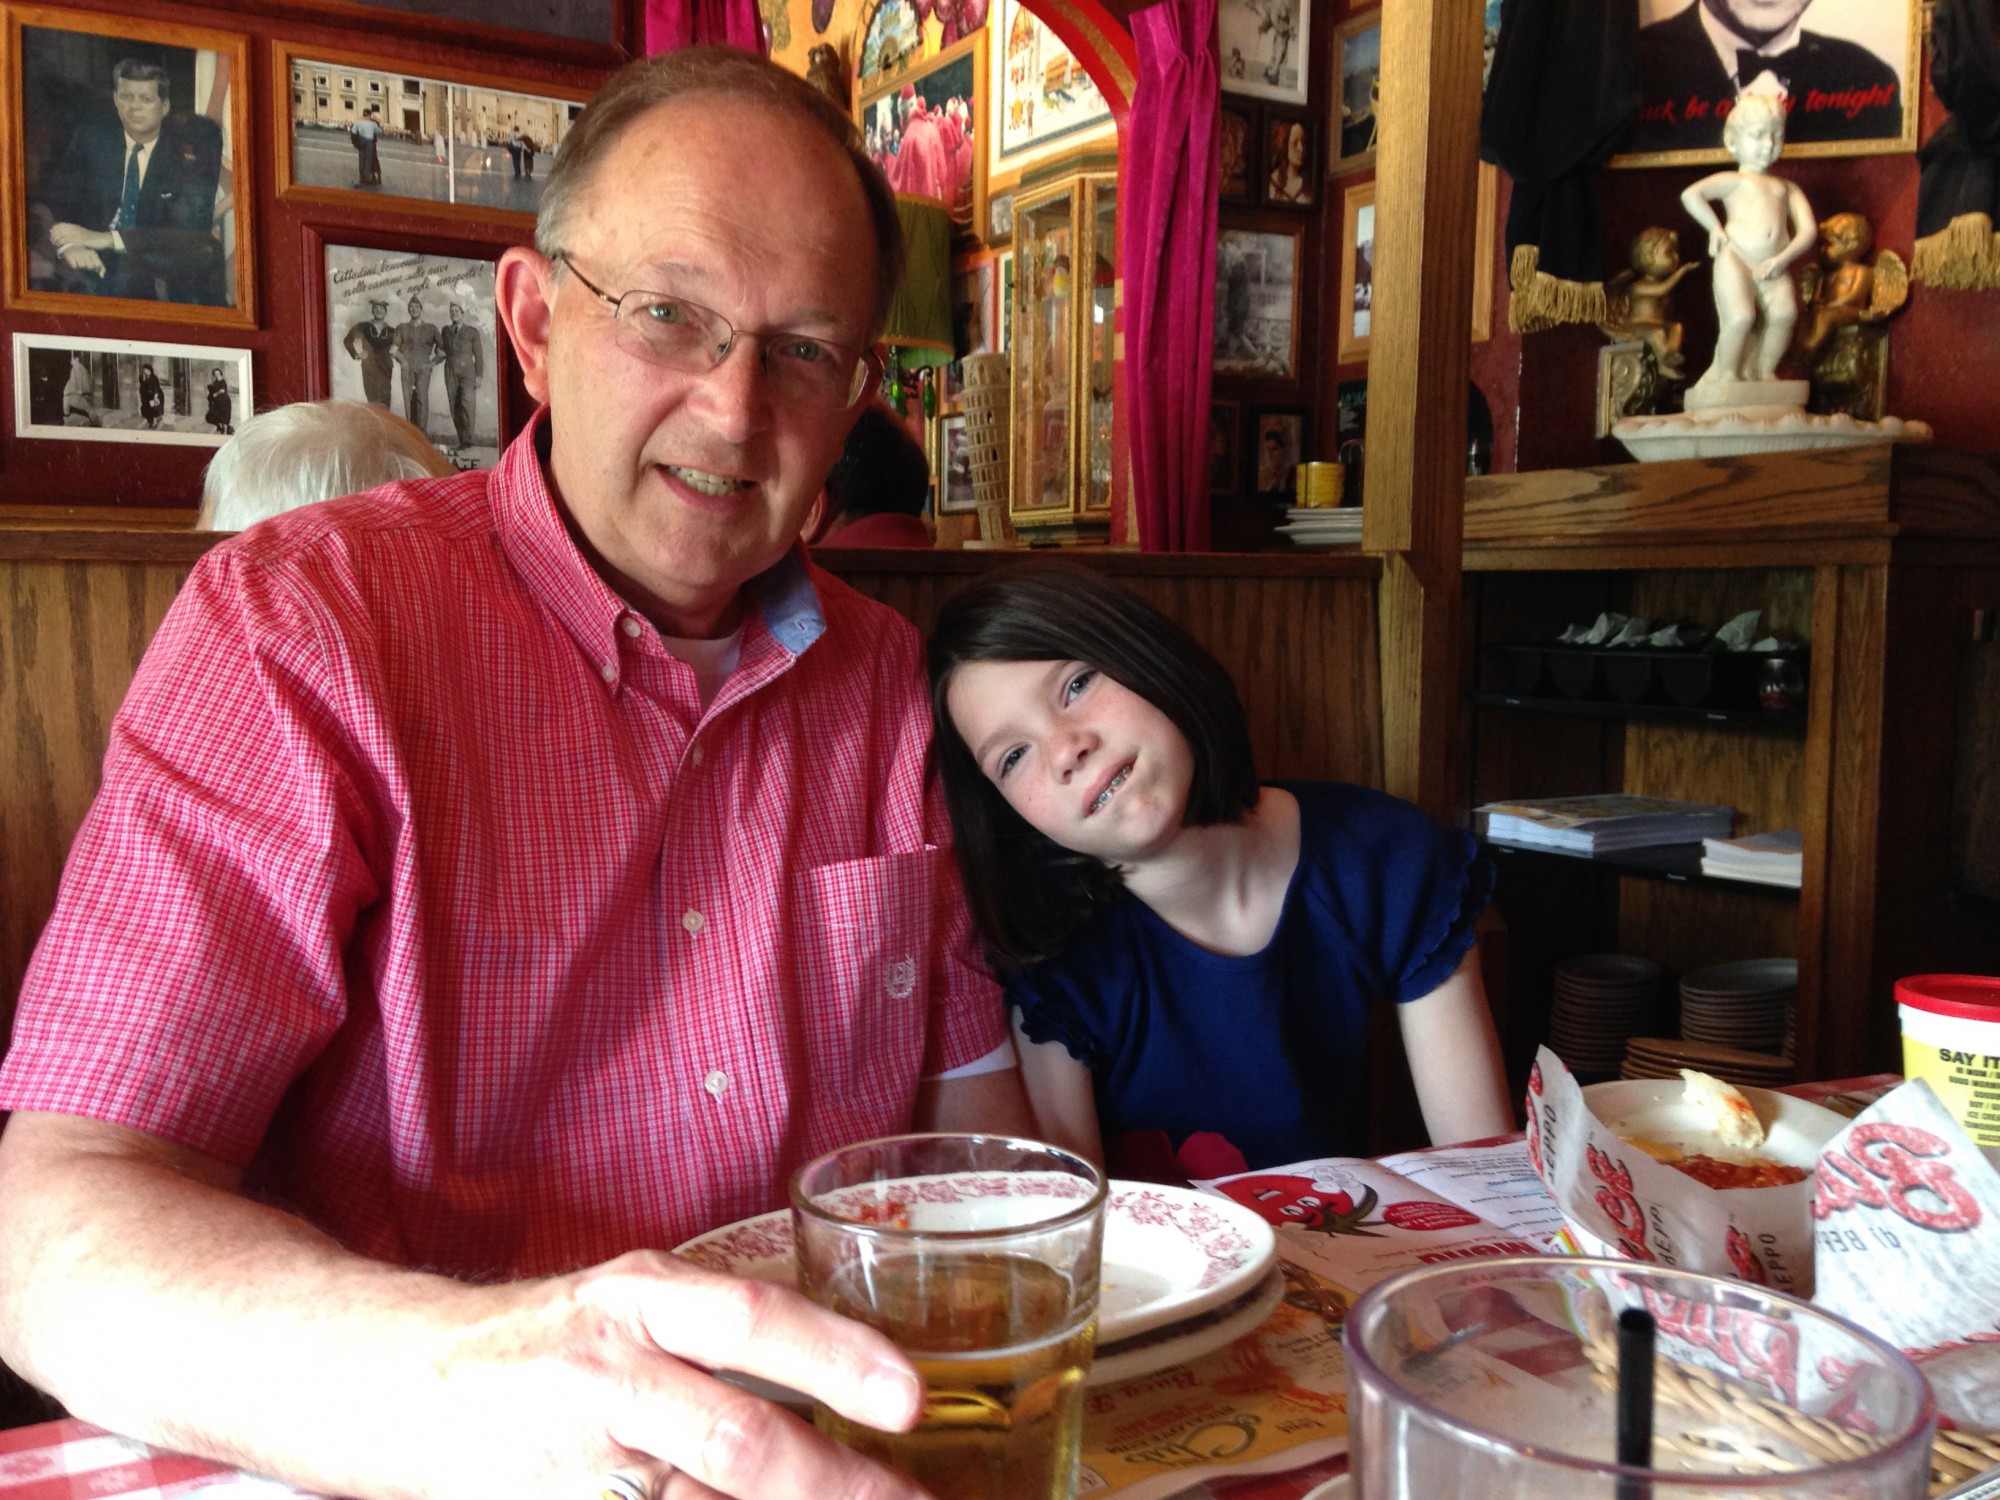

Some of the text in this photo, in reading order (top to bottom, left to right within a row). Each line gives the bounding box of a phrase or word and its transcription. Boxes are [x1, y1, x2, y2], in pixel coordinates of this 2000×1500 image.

[1638, 100, 1677, 124] uck
[1684, 95, 1708, 120] be
[1804, 84, 1896, 119] tonight
[1939, 1048, 1976, 1066] SAY
